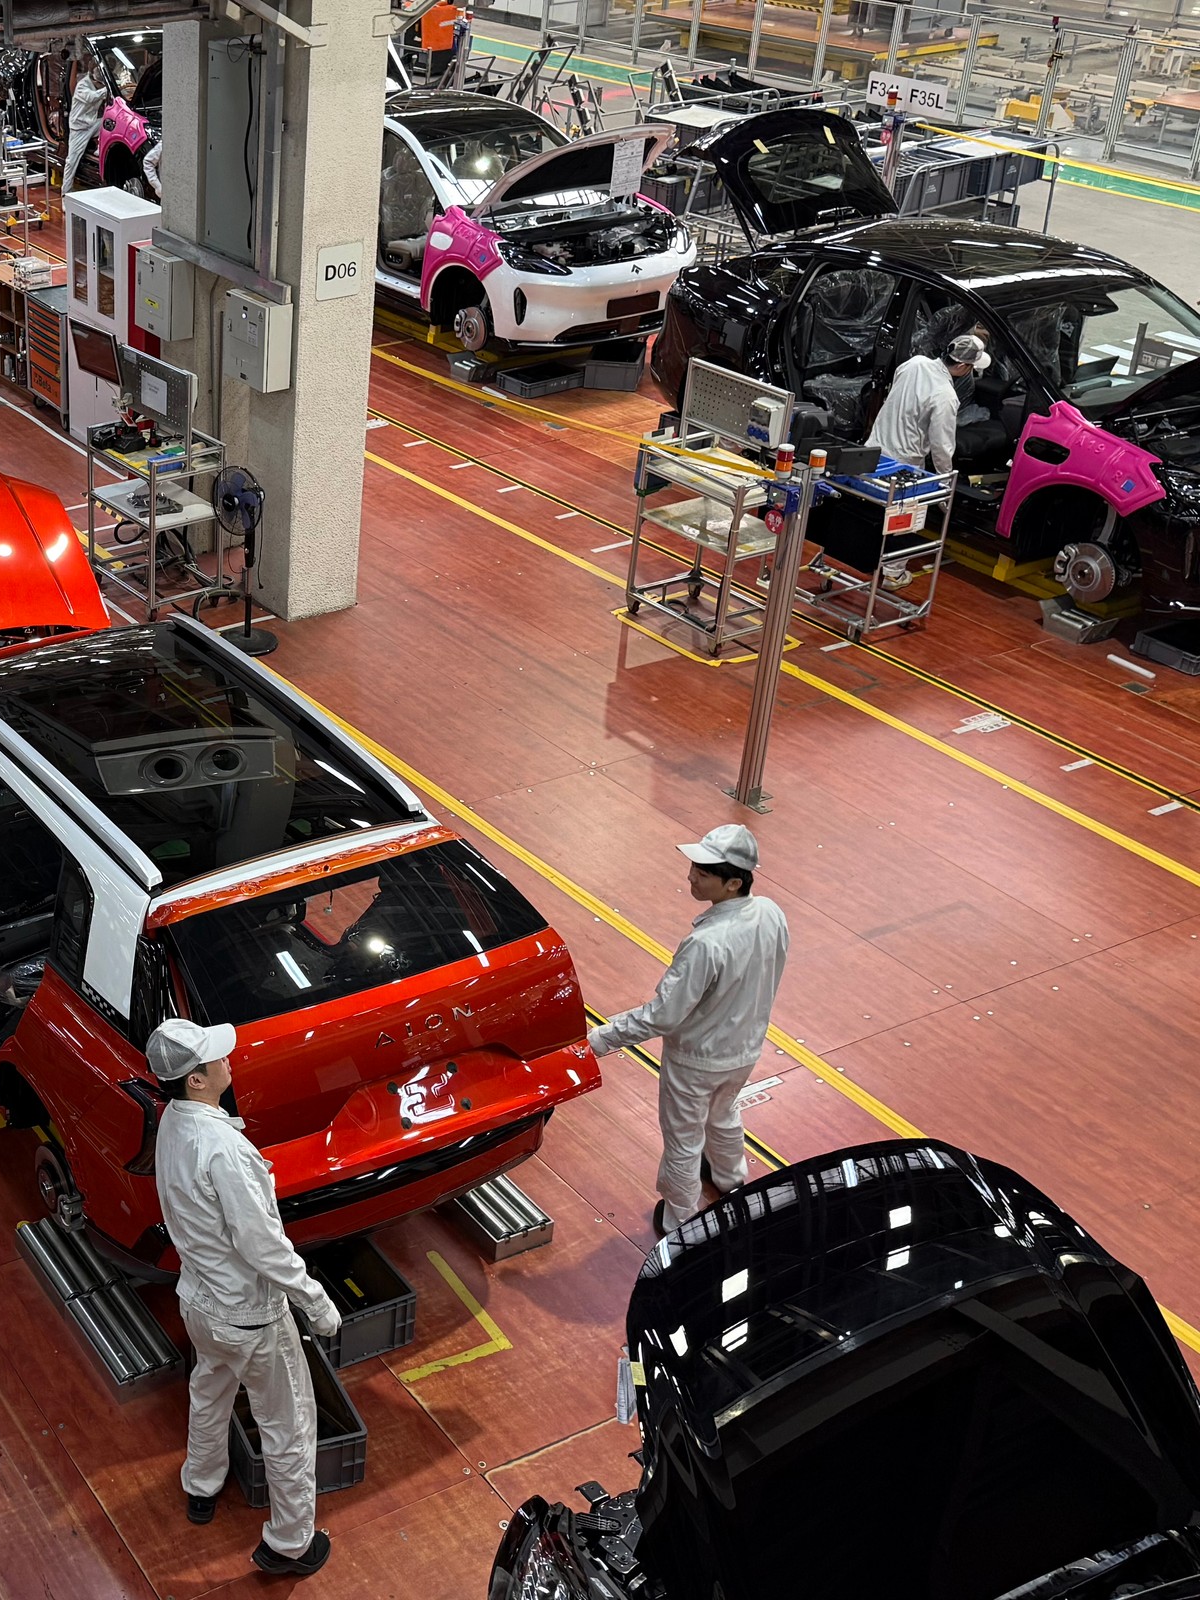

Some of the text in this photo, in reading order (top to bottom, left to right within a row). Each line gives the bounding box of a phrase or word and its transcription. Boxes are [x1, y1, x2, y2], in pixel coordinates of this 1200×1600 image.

[909, 88, 943, 110] F35L
[324, 261, 357, 281] D06
[375, 1003, 475, 1048] AION
